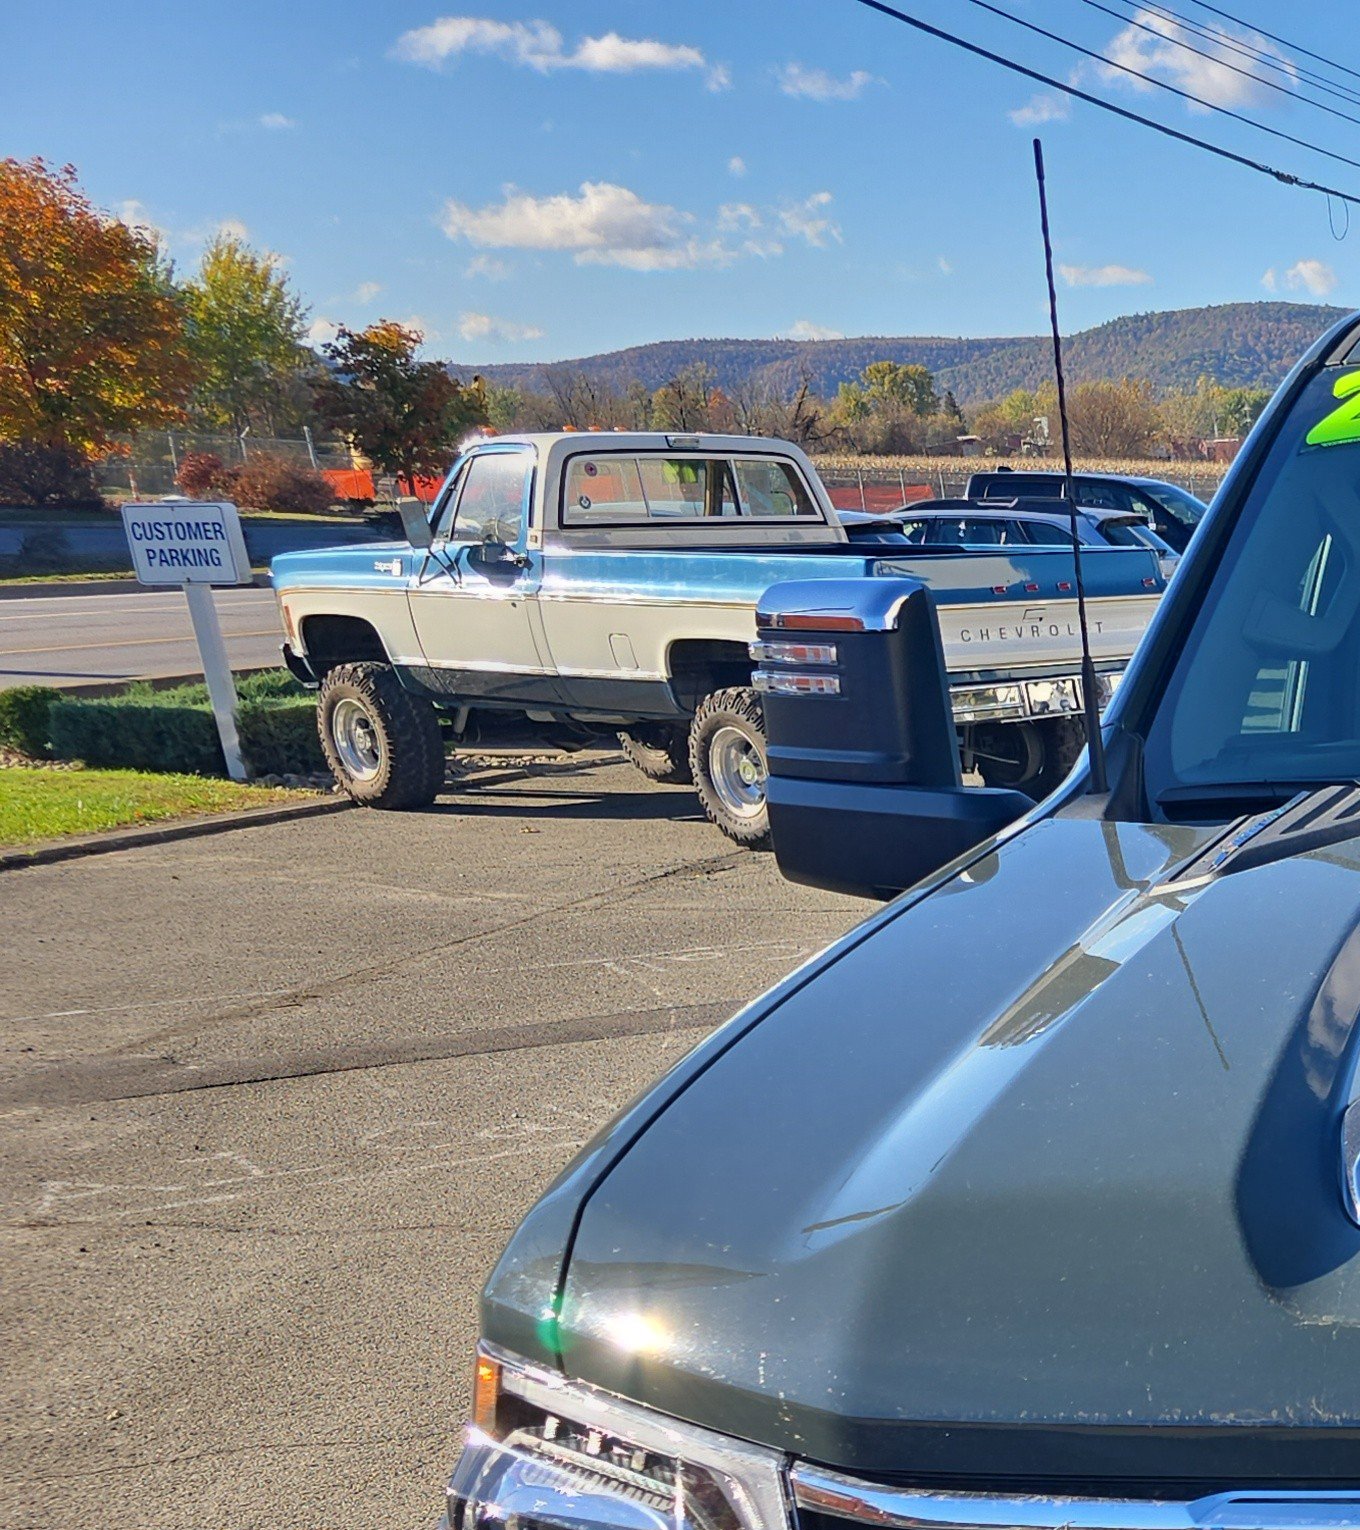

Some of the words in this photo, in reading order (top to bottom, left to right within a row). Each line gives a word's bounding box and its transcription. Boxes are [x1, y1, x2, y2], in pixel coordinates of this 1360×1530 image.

[131, 522, 225, 541] CUSTOMER
[145, 548, 222, 567] PARKING
[961, 622, 1103, 642] CHEVROLT
